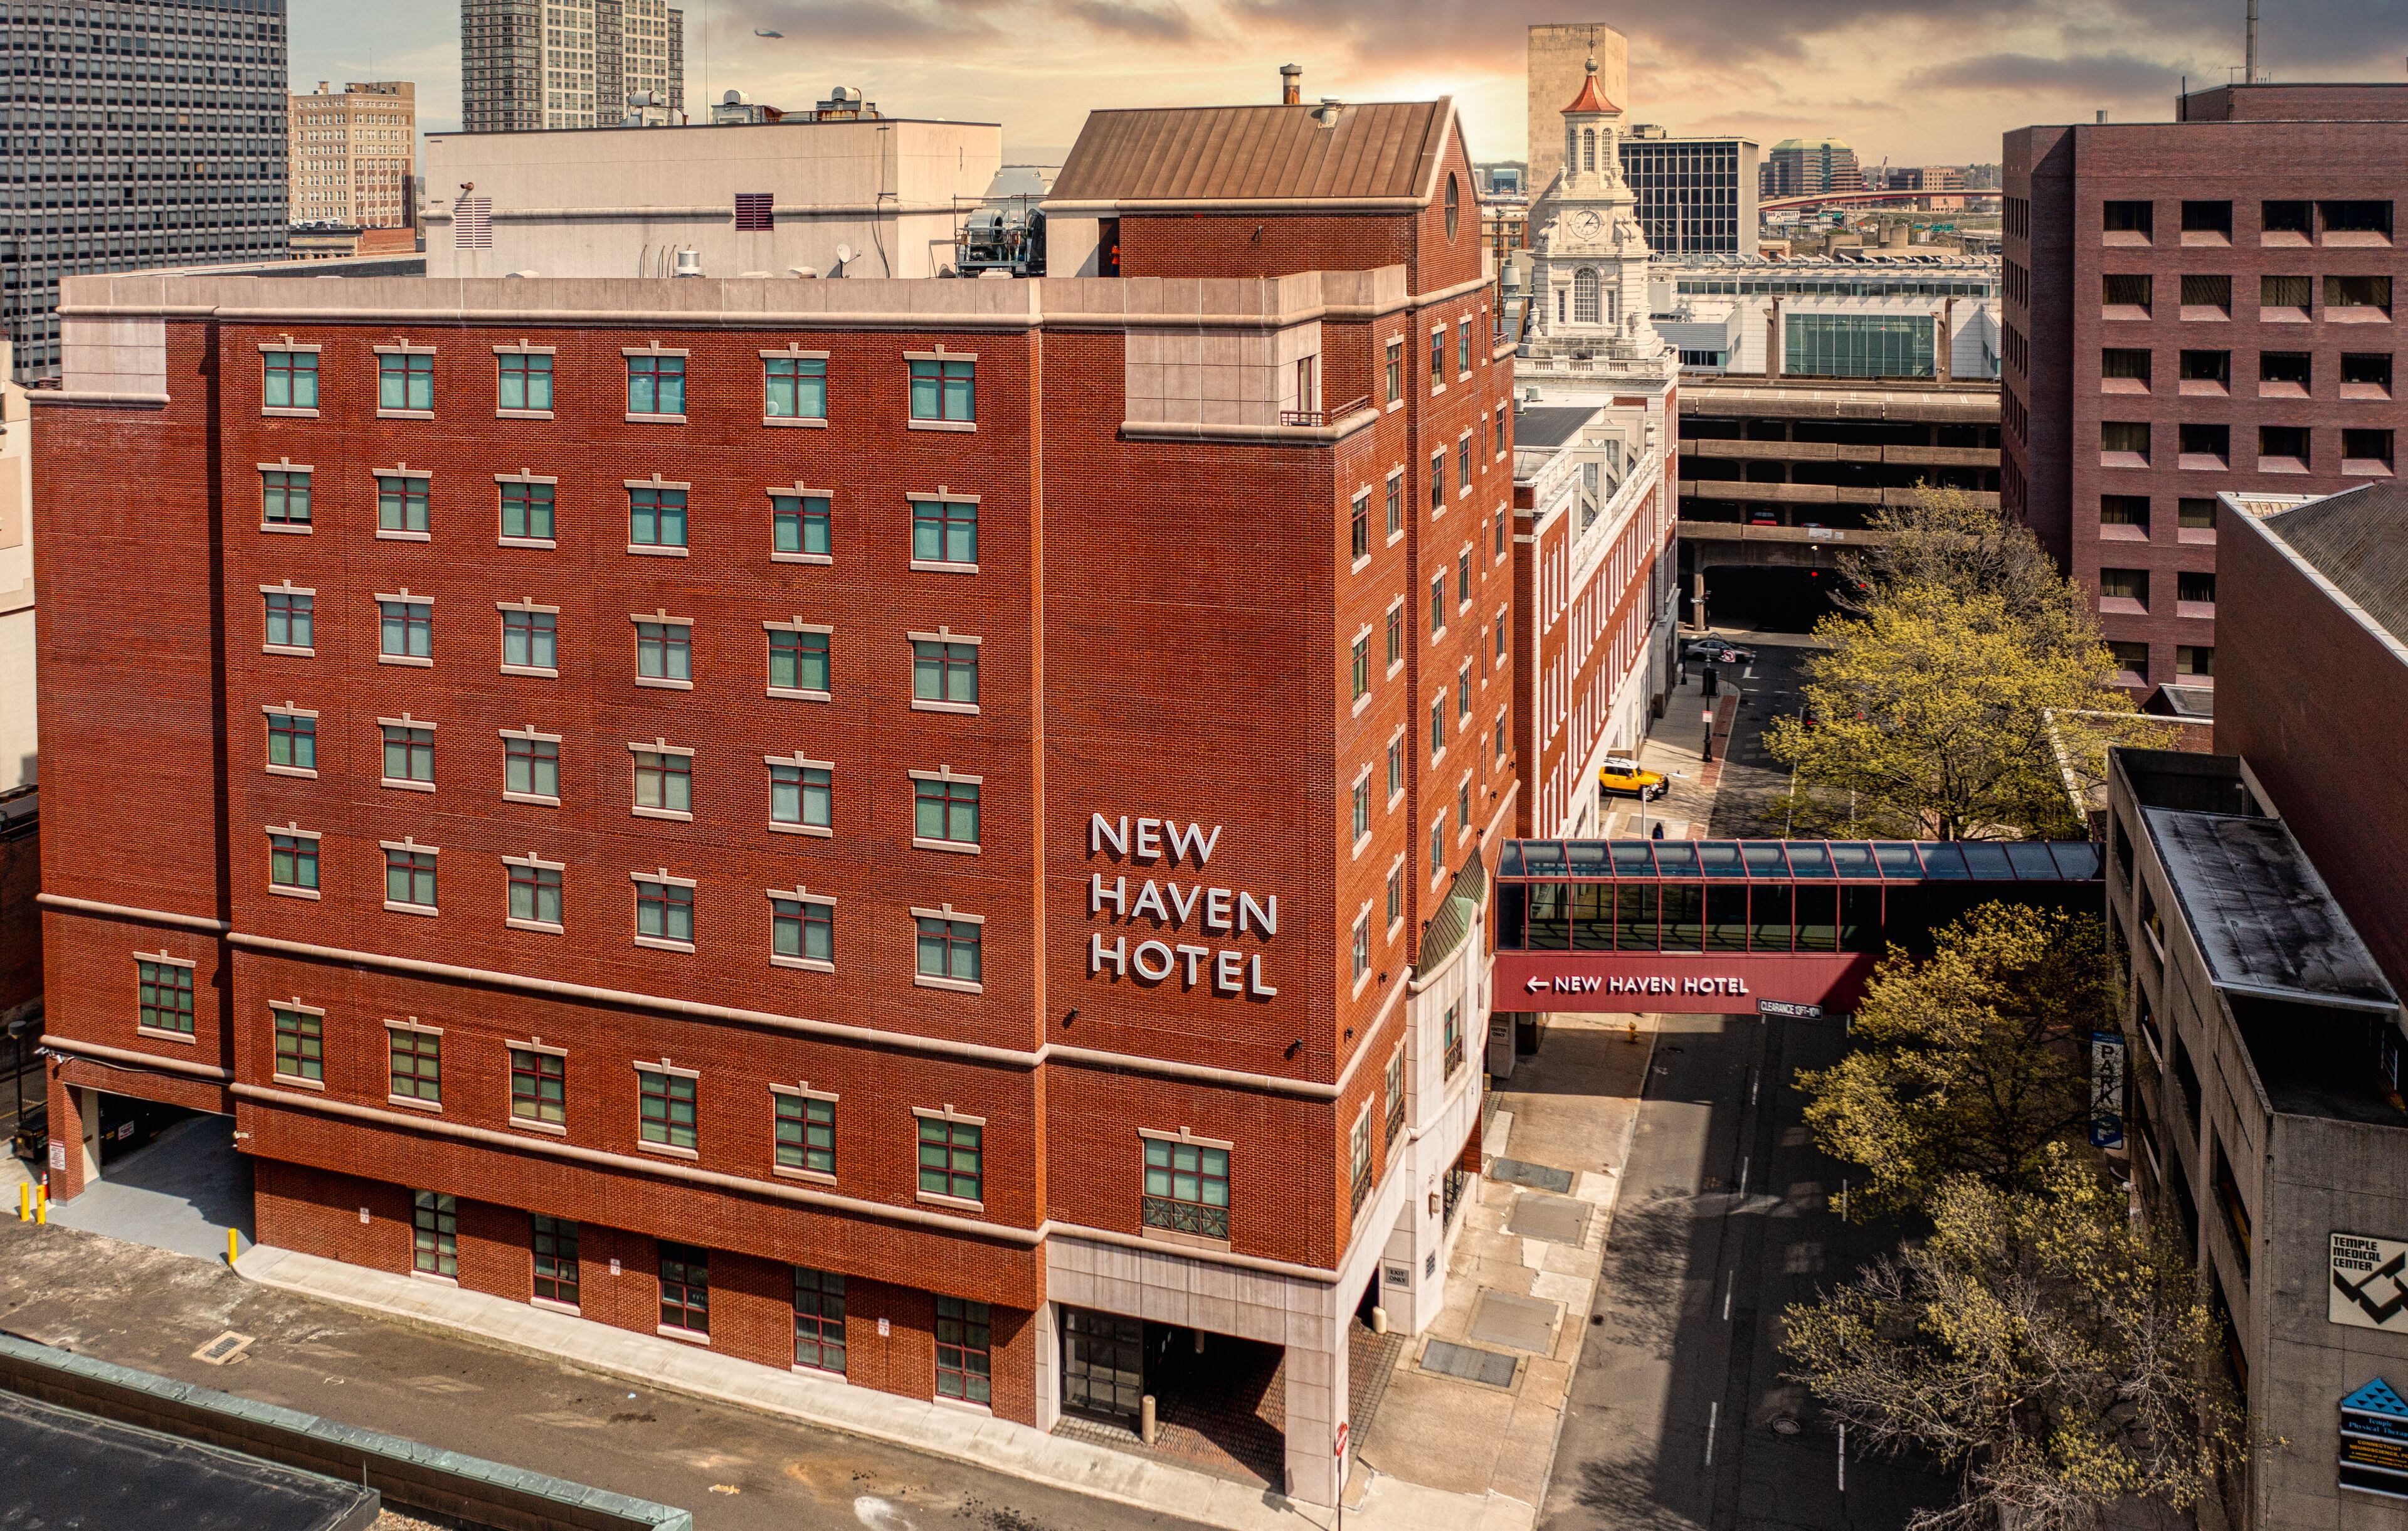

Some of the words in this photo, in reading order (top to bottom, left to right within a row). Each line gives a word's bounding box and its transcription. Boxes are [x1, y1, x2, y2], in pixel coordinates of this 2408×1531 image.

[1092, 813, 1222, 864] NEW
[1092, 873, 1277, 935] HAVEN
[1092, 933, 1277, 996] HOTEL
[1555, 976, 1602, 991] NEW
[1610, 976, 1676, 992] HAVEN
[1684, 977, 1750, 993] HOTEL
[1760, 1001, 1795, 1015] CLEARANCE
[2101, 1045, 2114, 1104] PARK
[2333, 1236, 2377, 1251] TEMPLE
[2333, 1247, 2381, 1263] MEDICAL
[2333, 1257, 2372, 1272] CENTER
[1389, 1275, 1405, 1283] ONLY
[2349, 1421, 2380, 1433] Physical
[2368, 1417, 2392, 1427] Temple
[2349, 1444, 2399, 1458] NEUROSCIENCE,
[2358, 1440, 2402, 1451] CONNECTICUT
